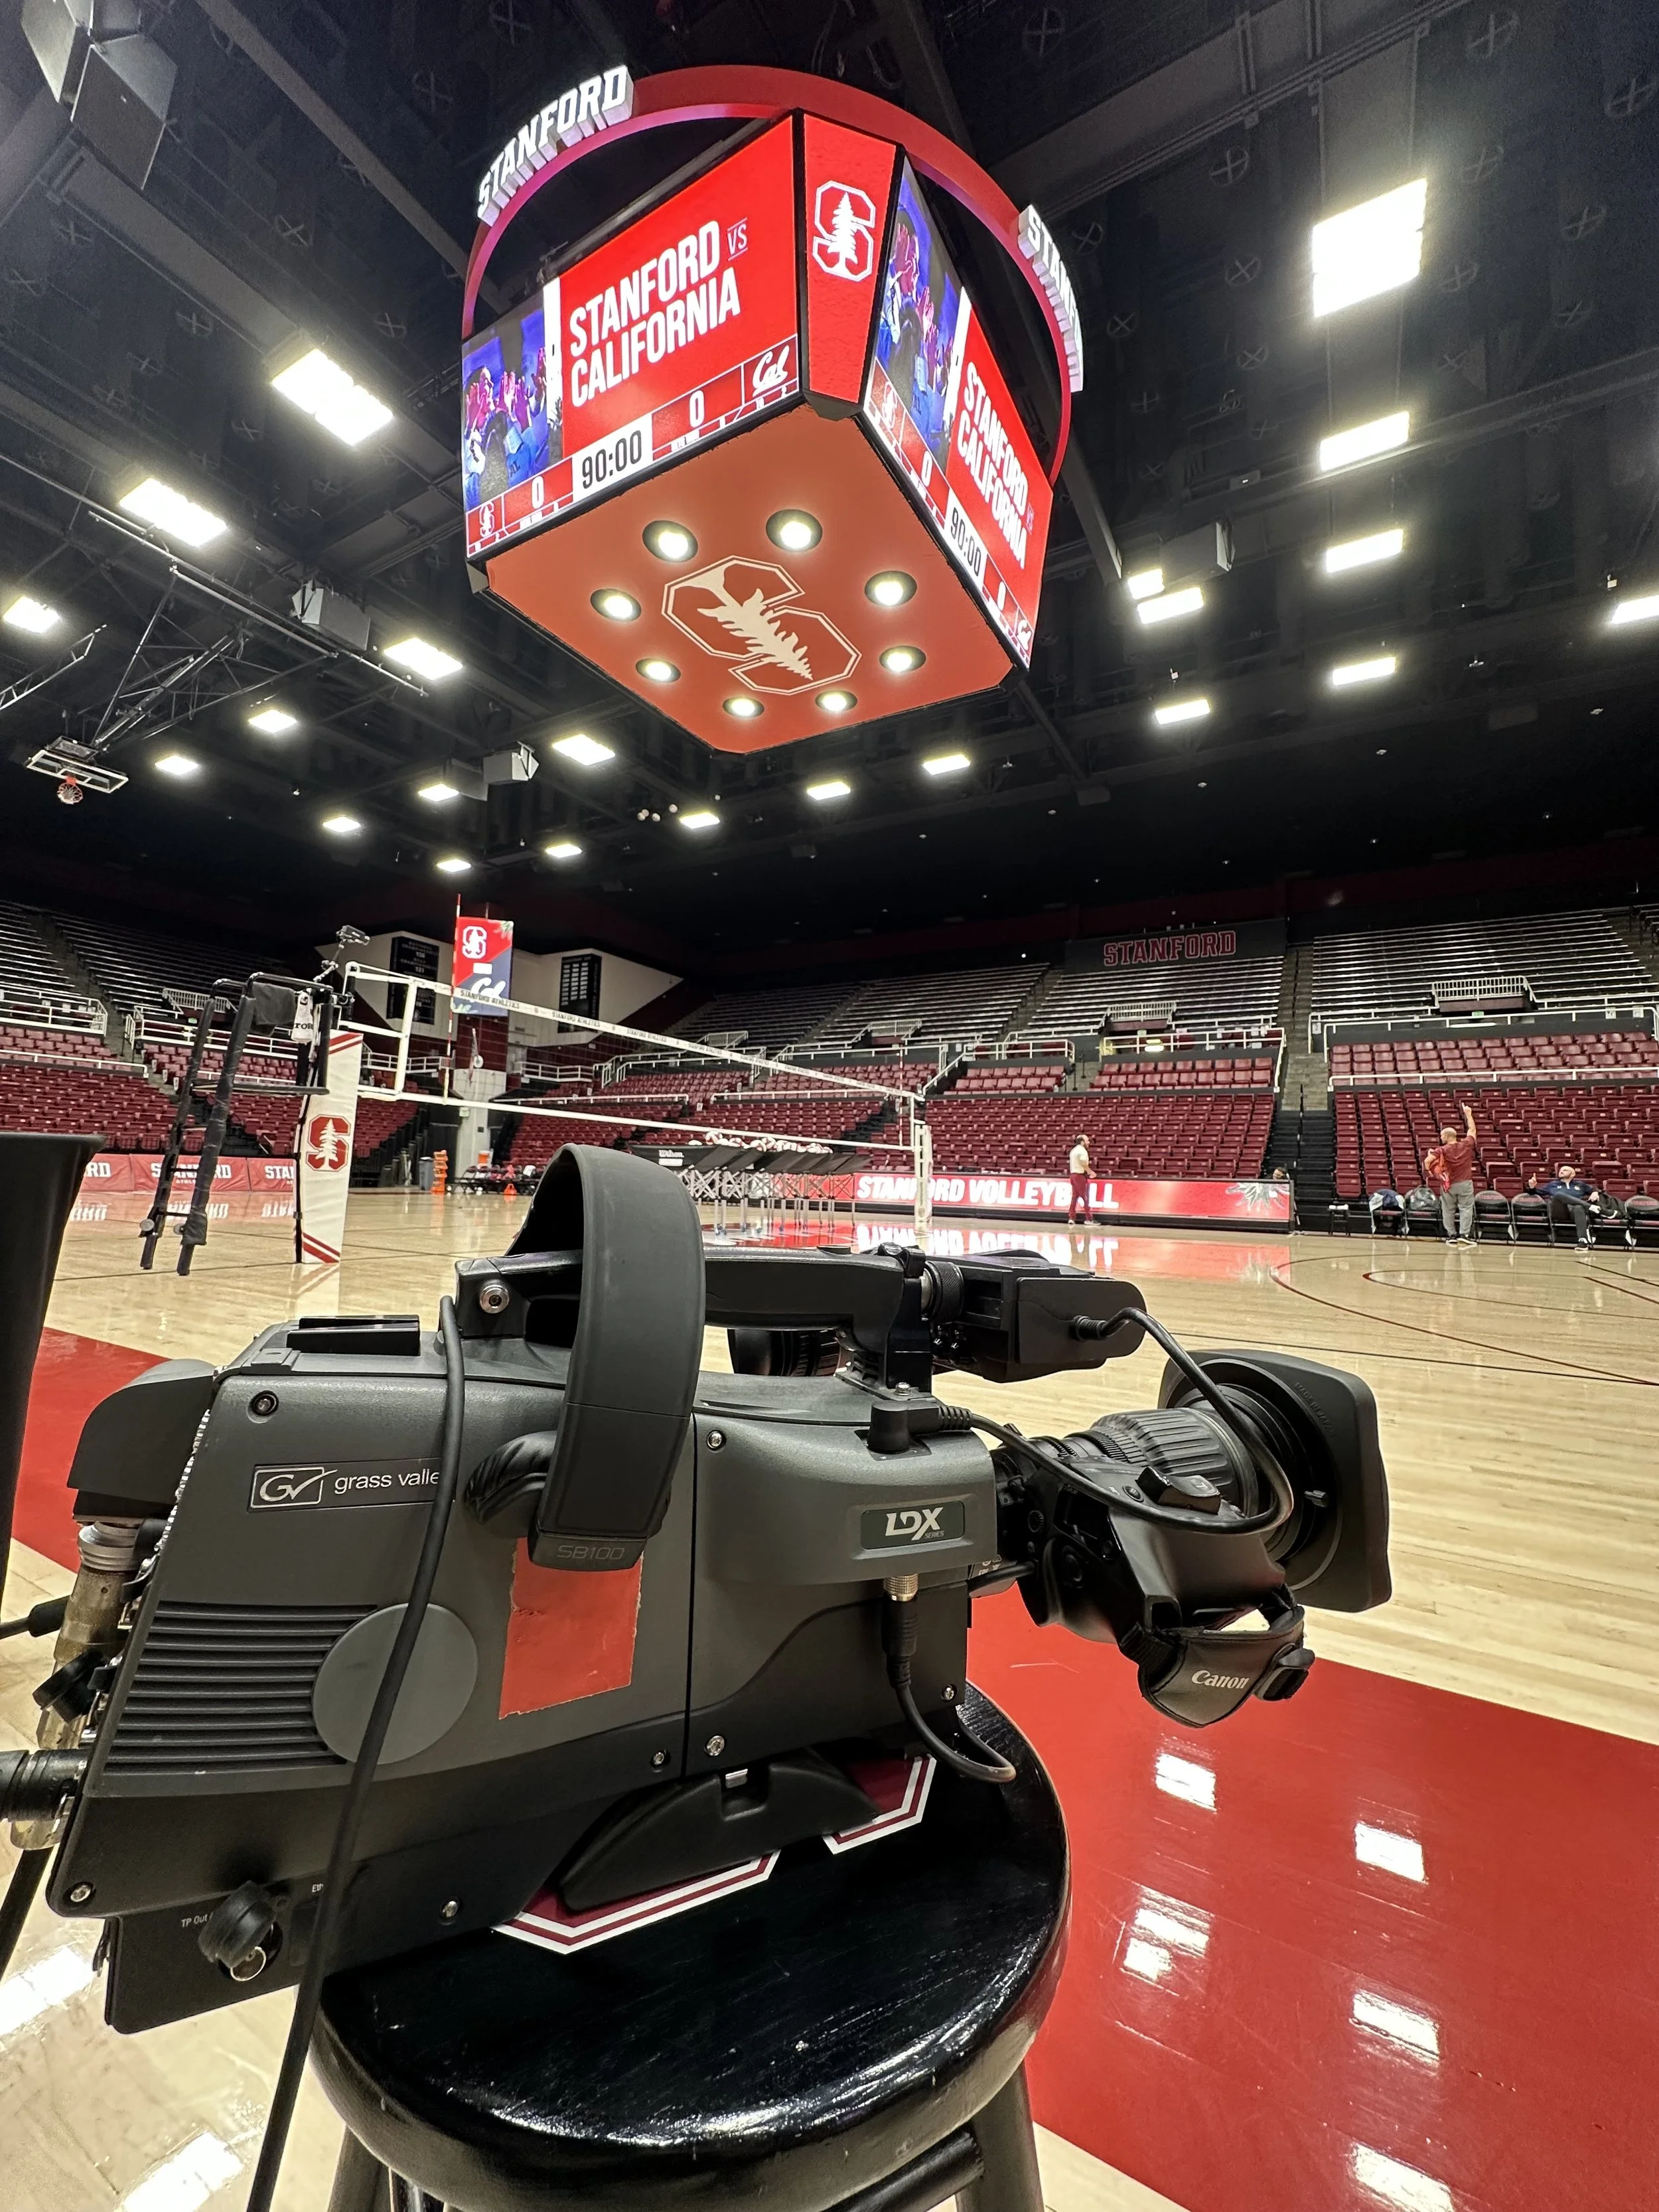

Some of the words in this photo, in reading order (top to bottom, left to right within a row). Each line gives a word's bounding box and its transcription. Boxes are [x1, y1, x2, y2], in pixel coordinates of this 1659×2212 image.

[477, 64, 629, 219] STANFORD
[570, 220, 720, 357] STANFORD
[727, 223, 748, 256] VS
[1028, 204, 1084, 391] STANF
[570, 267, 741, 407] CALIFORNIA
[752, 344, 790, 397] Cal
[689, 390, 705, 428] 0
[965, 362, 1029, 516] STANFORD
[581, 430, 642, 490] 90:00
[921, 451, 933, 487] 0
[532, 475, 545, 509] 0
[958, 409, 1027, 571] CALIFORNIA
[950, 507, 981, 577] 90:00
[1104, 930, 1236, 967] STANFORD
[461, 990, 490, 1003] STANFORD
[969, 1179, 1120, 1209] VOLLEYBLL
[334, 1473, 392, 1495] grass
[398, 1469, 440, 1487] valle
[885, 1507, 944, 1541] LDX
[924, 1530, 944, 1539] SERIES
[557, 1545, 625, 1560] SB100
[1191, 1670, 1250, 1689] Canon
[181, 1917, 192, 1927] TP
[194, 1913, 208, 1925] Out
